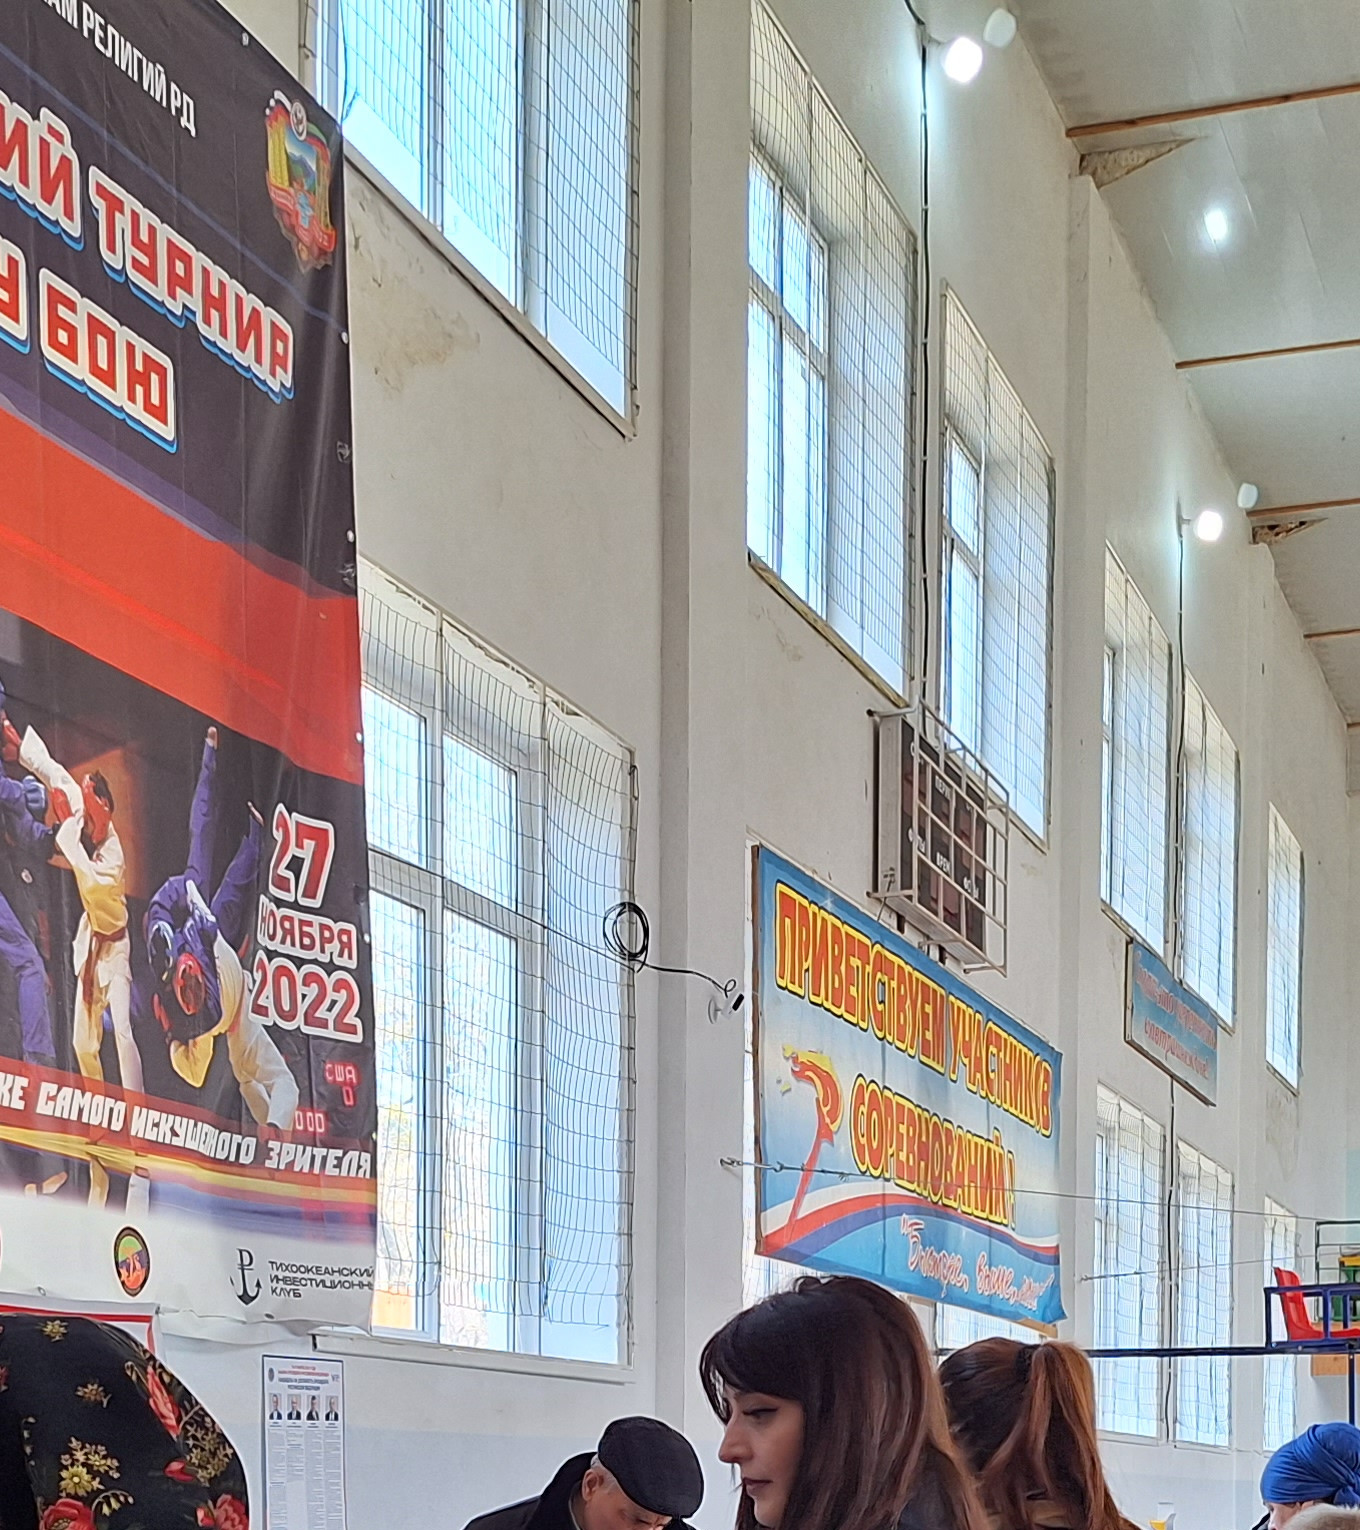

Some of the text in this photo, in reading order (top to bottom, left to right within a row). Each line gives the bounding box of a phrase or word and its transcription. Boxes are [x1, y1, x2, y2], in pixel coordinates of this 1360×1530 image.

[82, 1, 168, 108] РЕЛИГИЙ
[170, 81, 197, 138] РД
[90, 168, 294, 394] ТУРНИР
[41, 270, 175, 442] БОЮ
[270, 804, 333, 907] 27
[258, 897, 356, 967] НОЯБРЯ
[250, 952, 362, 1042] 2022
[775, 880, 947, 1075] ПРИВЕТСТВУЕМ
[948, 993, 1053, 1137] УЧАСТНИКОВ
[35, 1081, 127, 1132] САМОГО
[264, 1140, 372, 1180] ЗРИТЕЛЯ
[268, 1260, 374, 1278] ТИХООКЕАНСКИЙ
[271, 1286, 302, 1298] КЛУБ
